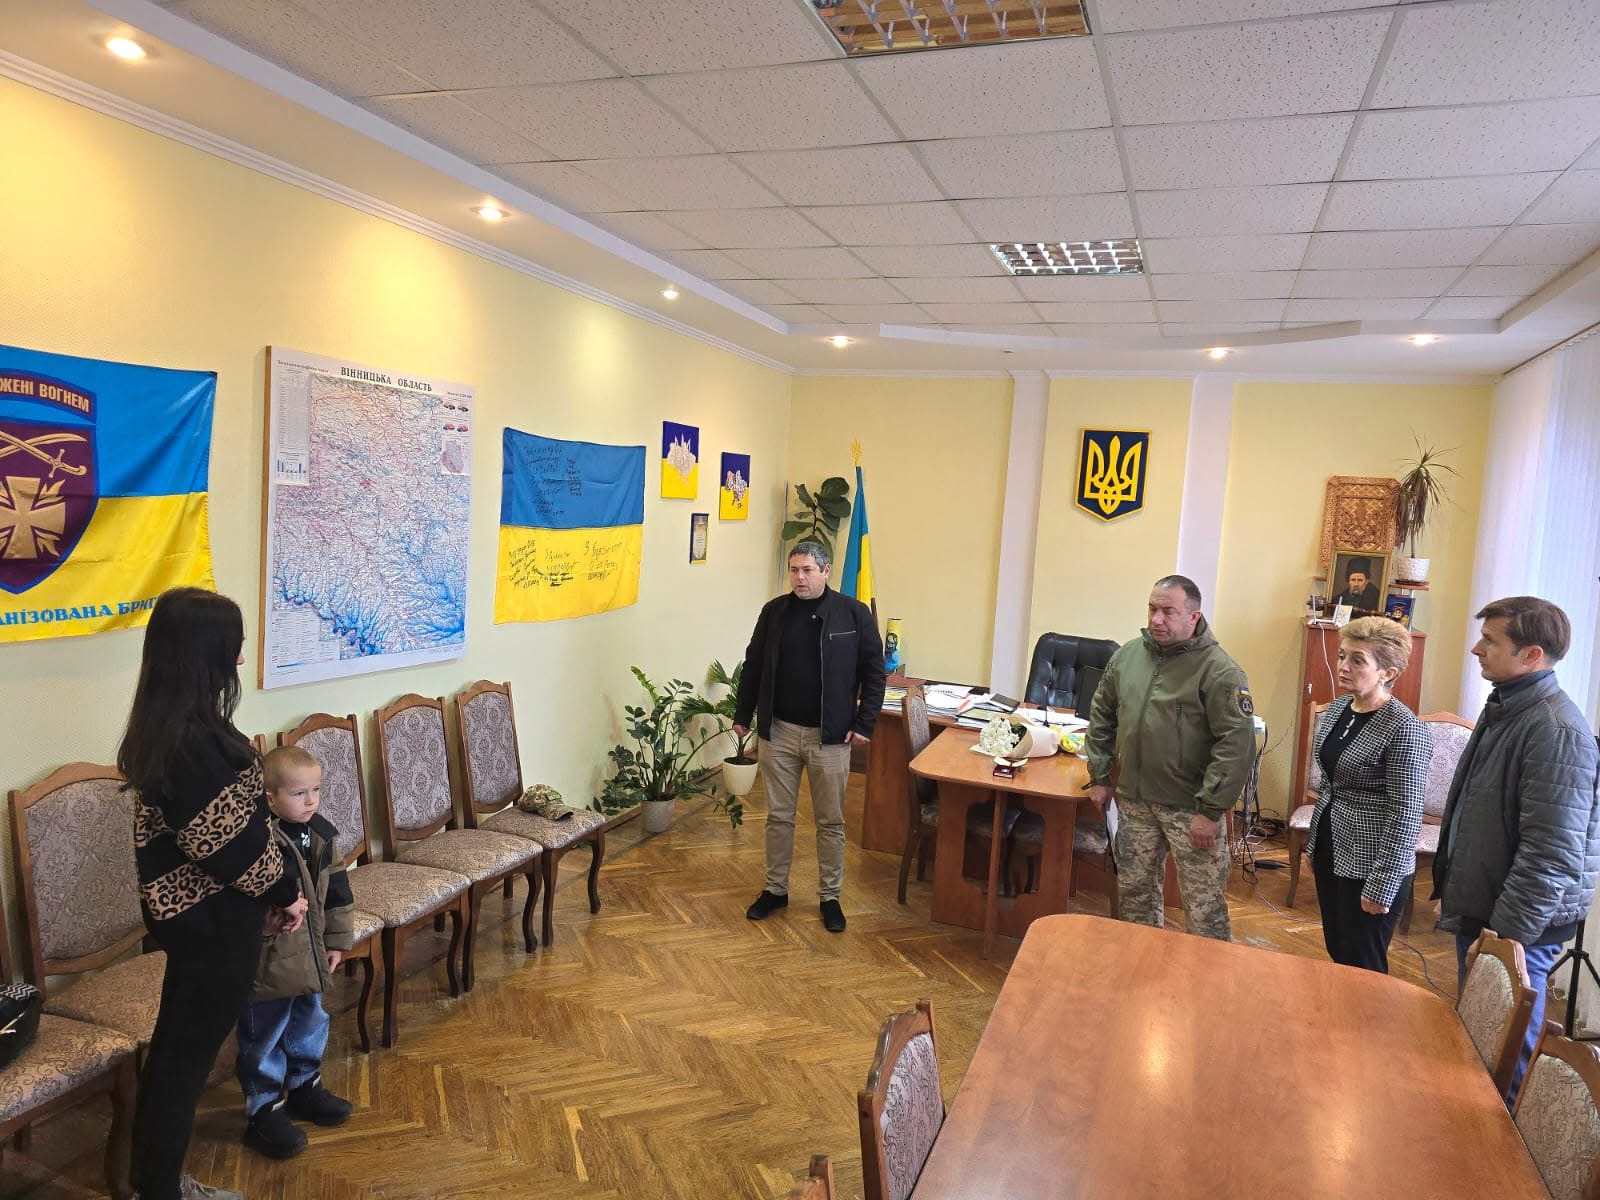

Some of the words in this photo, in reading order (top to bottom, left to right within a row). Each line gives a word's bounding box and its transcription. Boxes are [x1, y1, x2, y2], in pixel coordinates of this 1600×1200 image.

[341, 366, 391, 384] ВІННИЦЬКА
[398, 378, 432, 392] ОБЛАСТЬ
[40, 383, 89, 412] ВОГНЕМ
